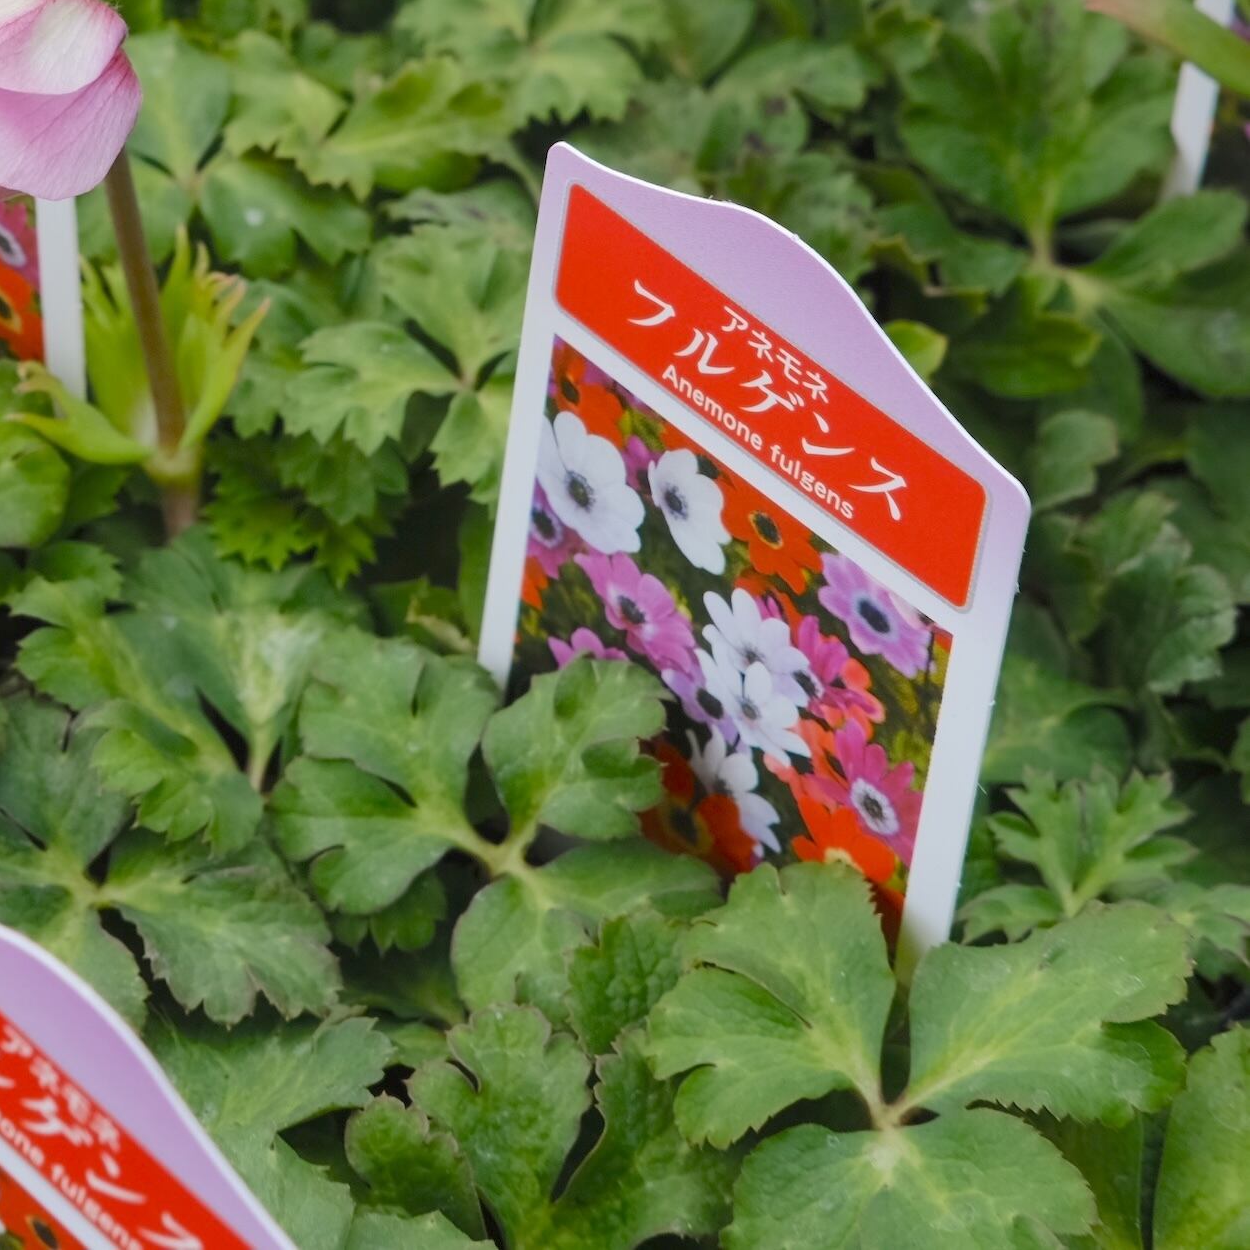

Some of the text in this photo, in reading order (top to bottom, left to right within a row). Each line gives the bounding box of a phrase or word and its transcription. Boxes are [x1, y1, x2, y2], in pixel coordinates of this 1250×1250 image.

[627, 278, 908, 521] フルゲンス
[721, 305, 829, 404] アネモネ
[661, 364, 854, 520] Anemone fulgens
[0, 1024, 121, 1151] アネモネ
